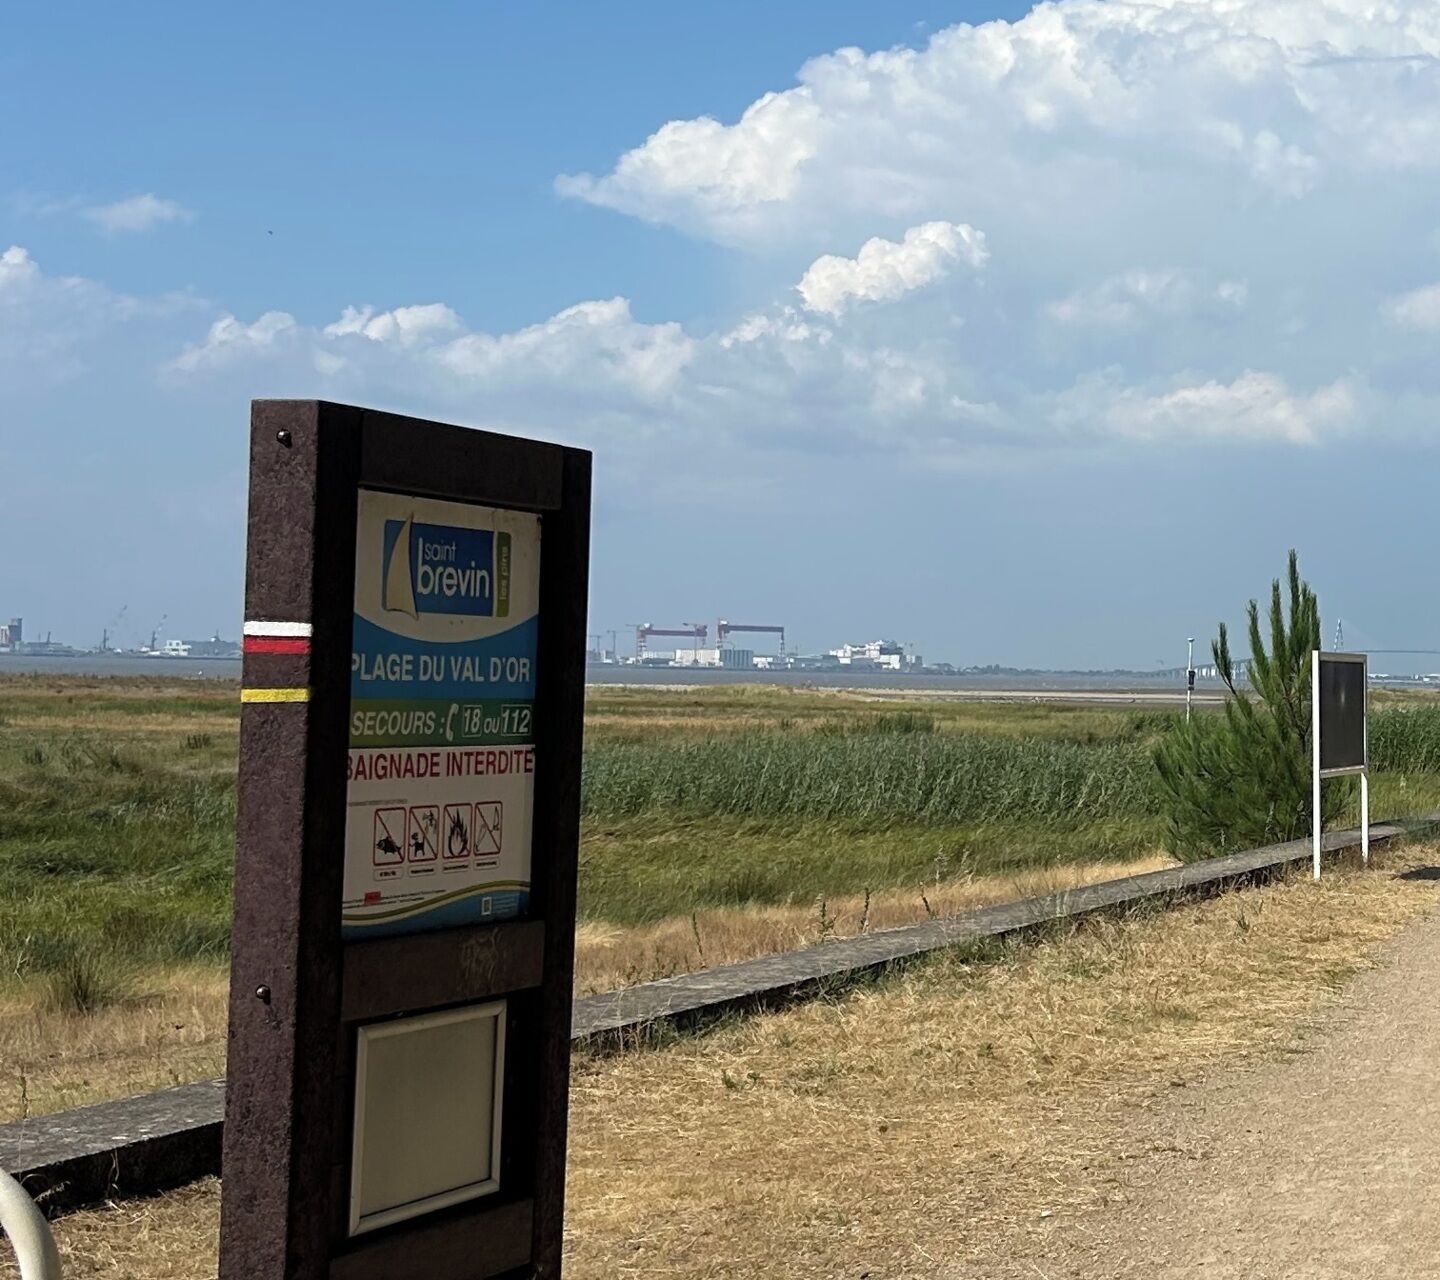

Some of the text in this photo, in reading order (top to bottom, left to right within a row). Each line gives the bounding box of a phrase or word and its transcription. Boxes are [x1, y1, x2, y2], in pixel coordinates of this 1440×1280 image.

[424, 539, 457, 562] saint
[416, 537, 489, 598] brevin
[419, 655, 445, 681] DU
[451, 656, 484, 682] VAL
[490, 657, 530, 683] D'OR
[351, 711, 435, 736] SECOURS
[463, 708, 480, 734] 18
[502, 708, 531, 734] 112
[446, 749, 533, 777] INTERDITE
